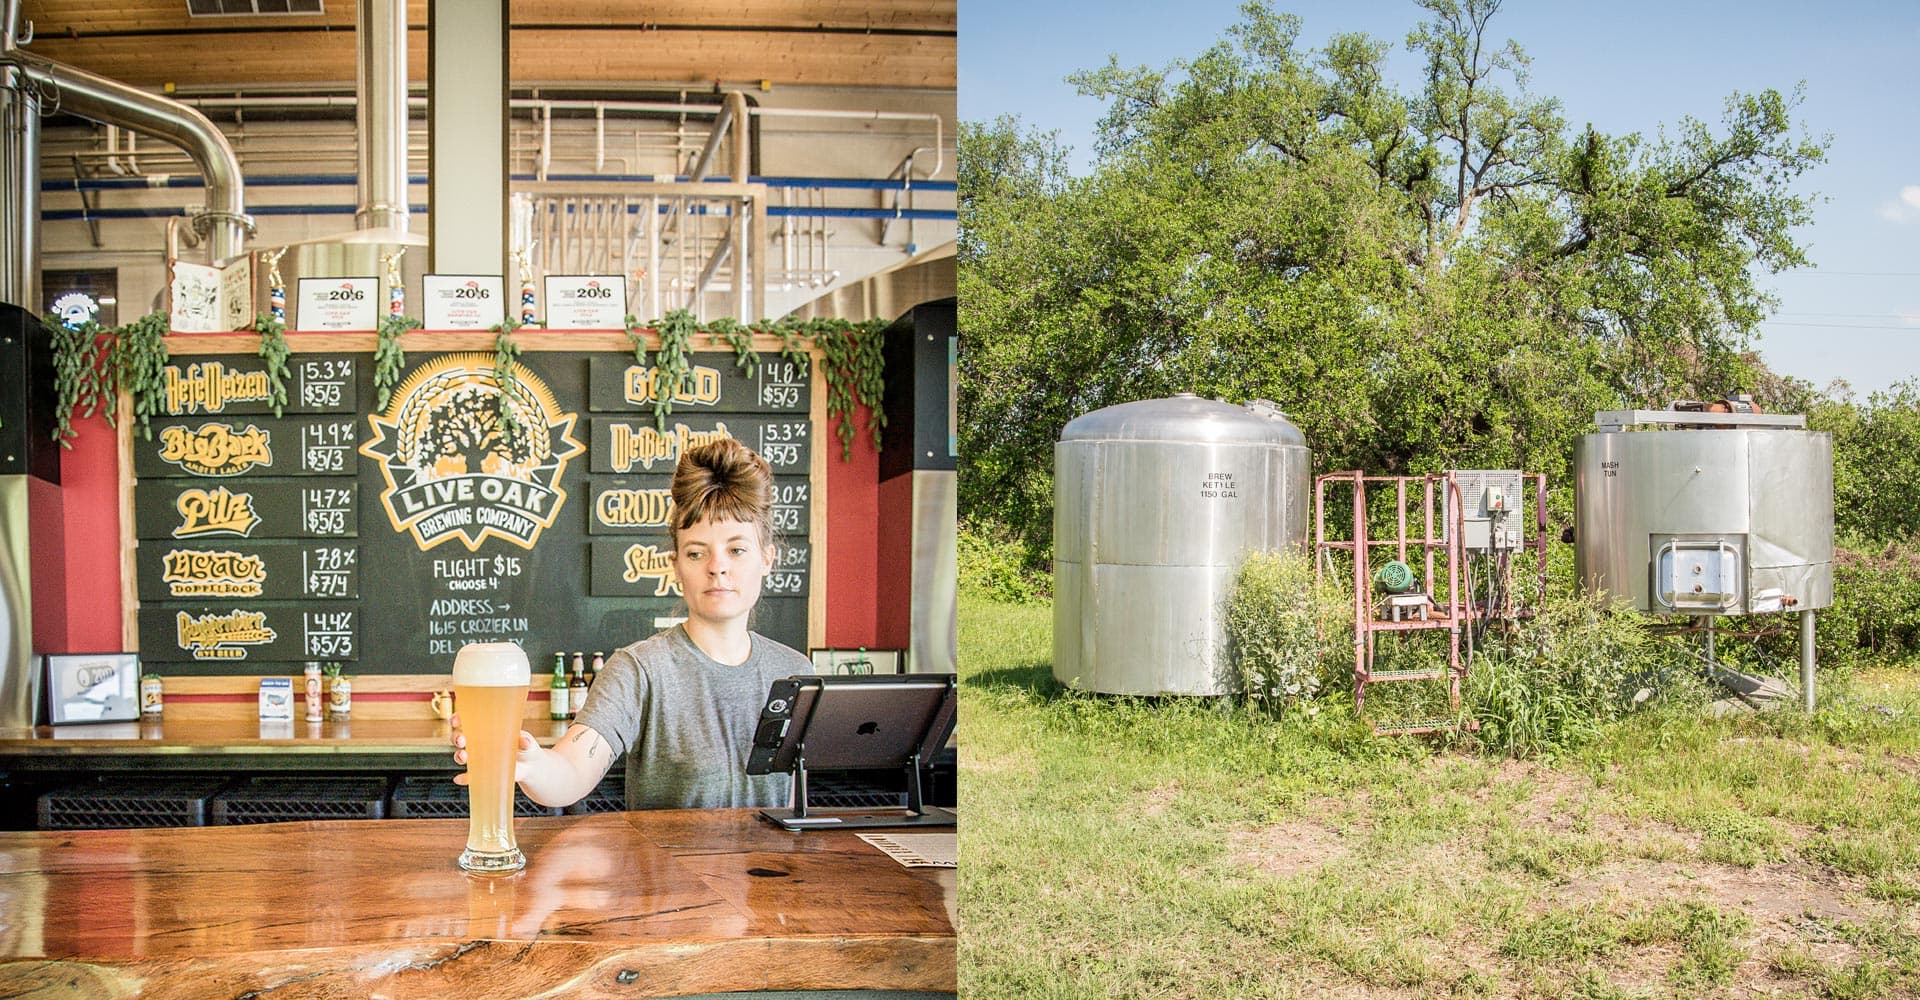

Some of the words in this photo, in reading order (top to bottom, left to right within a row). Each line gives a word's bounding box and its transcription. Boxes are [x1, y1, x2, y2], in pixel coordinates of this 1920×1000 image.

[304, 385, 341, 404] $5/3
[763, 385, 798, 406] $5/3
[307, 450, 343, 469] $5/3
[763, 446, 798, 466] $5/3
[220, 462, 250, 475] LAGER
[401, 478, 475, 514] LIVE
[480, 478, 548, 513] OAK
[308, 511, 344, 533] $5/3
[419, 507, 473, 539] BREWING
[476, 507, 536, 537] COMPANY
[433, 558, 490, 578] FLIGHT
[493, 554, 522, 577] $15
[309, 574, 347, 594] $7/4
[449, 579, 487, 591] CHOOSE
[488, 577, 498, 590] 4
[765, 573, 802, 590] $5/3
[430, 599, 494, 616] ADDRESS
[429, 620, 457, 635] 1615
[460, 618, 512, 634] CROZIER
[513, 618, 529, 632] LN
[310, 636, 352, 655] $5/3
[430, 639, 456, 654] DEL
